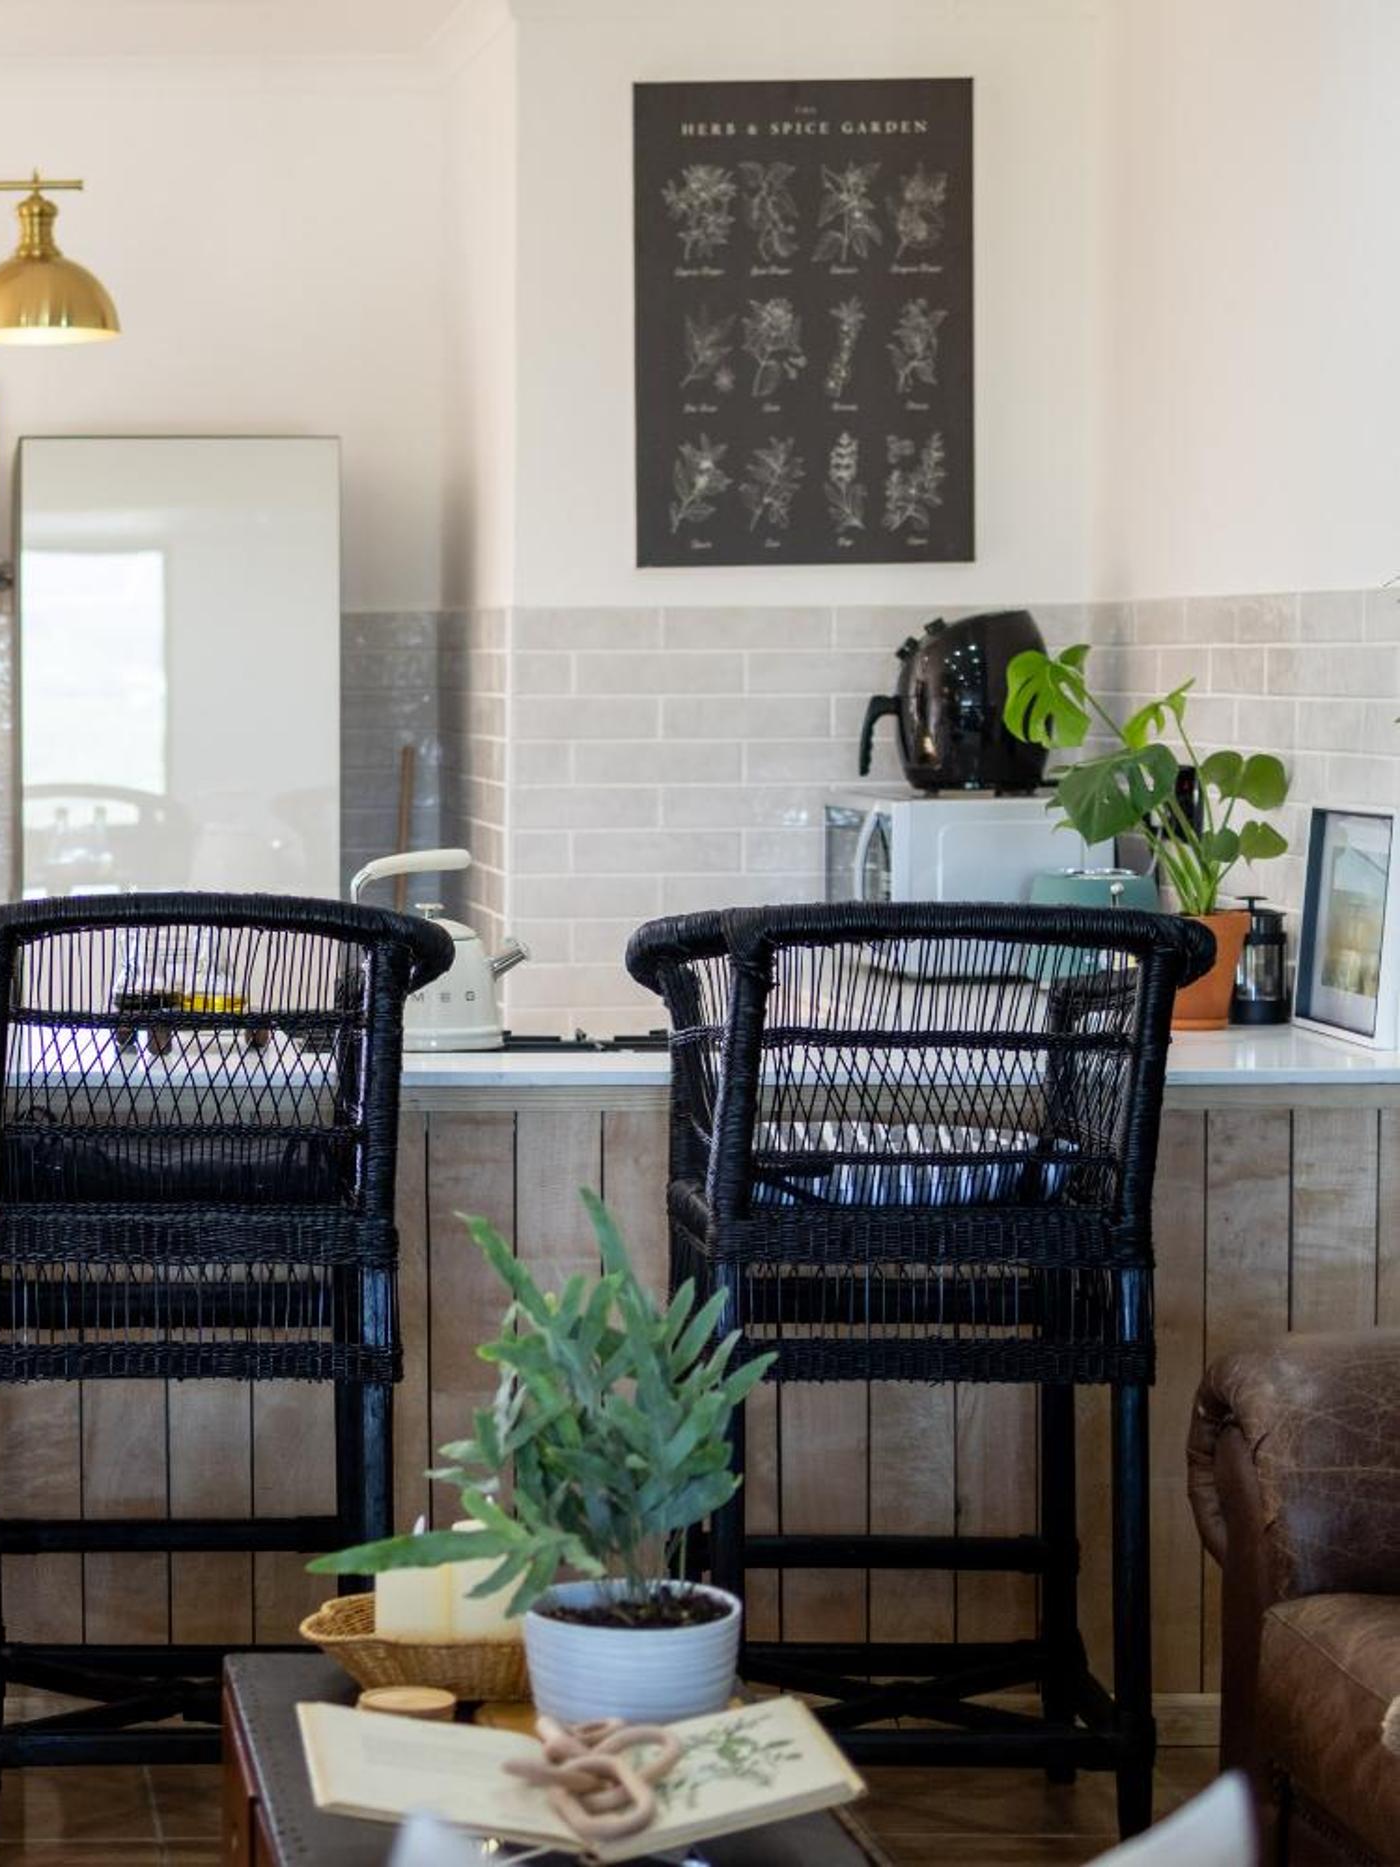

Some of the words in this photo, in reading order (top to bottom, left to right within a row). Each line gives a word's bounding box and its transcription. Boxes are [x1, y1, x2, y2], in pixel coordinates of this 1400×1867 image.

[680, 122, 736, 136] HERB
[746, 123, 758, 136] &
[769, 121, 830, 136] SPICE
[840, 120, 928, 135] GARDEN
[412, 991, 476, 1003] MEG
